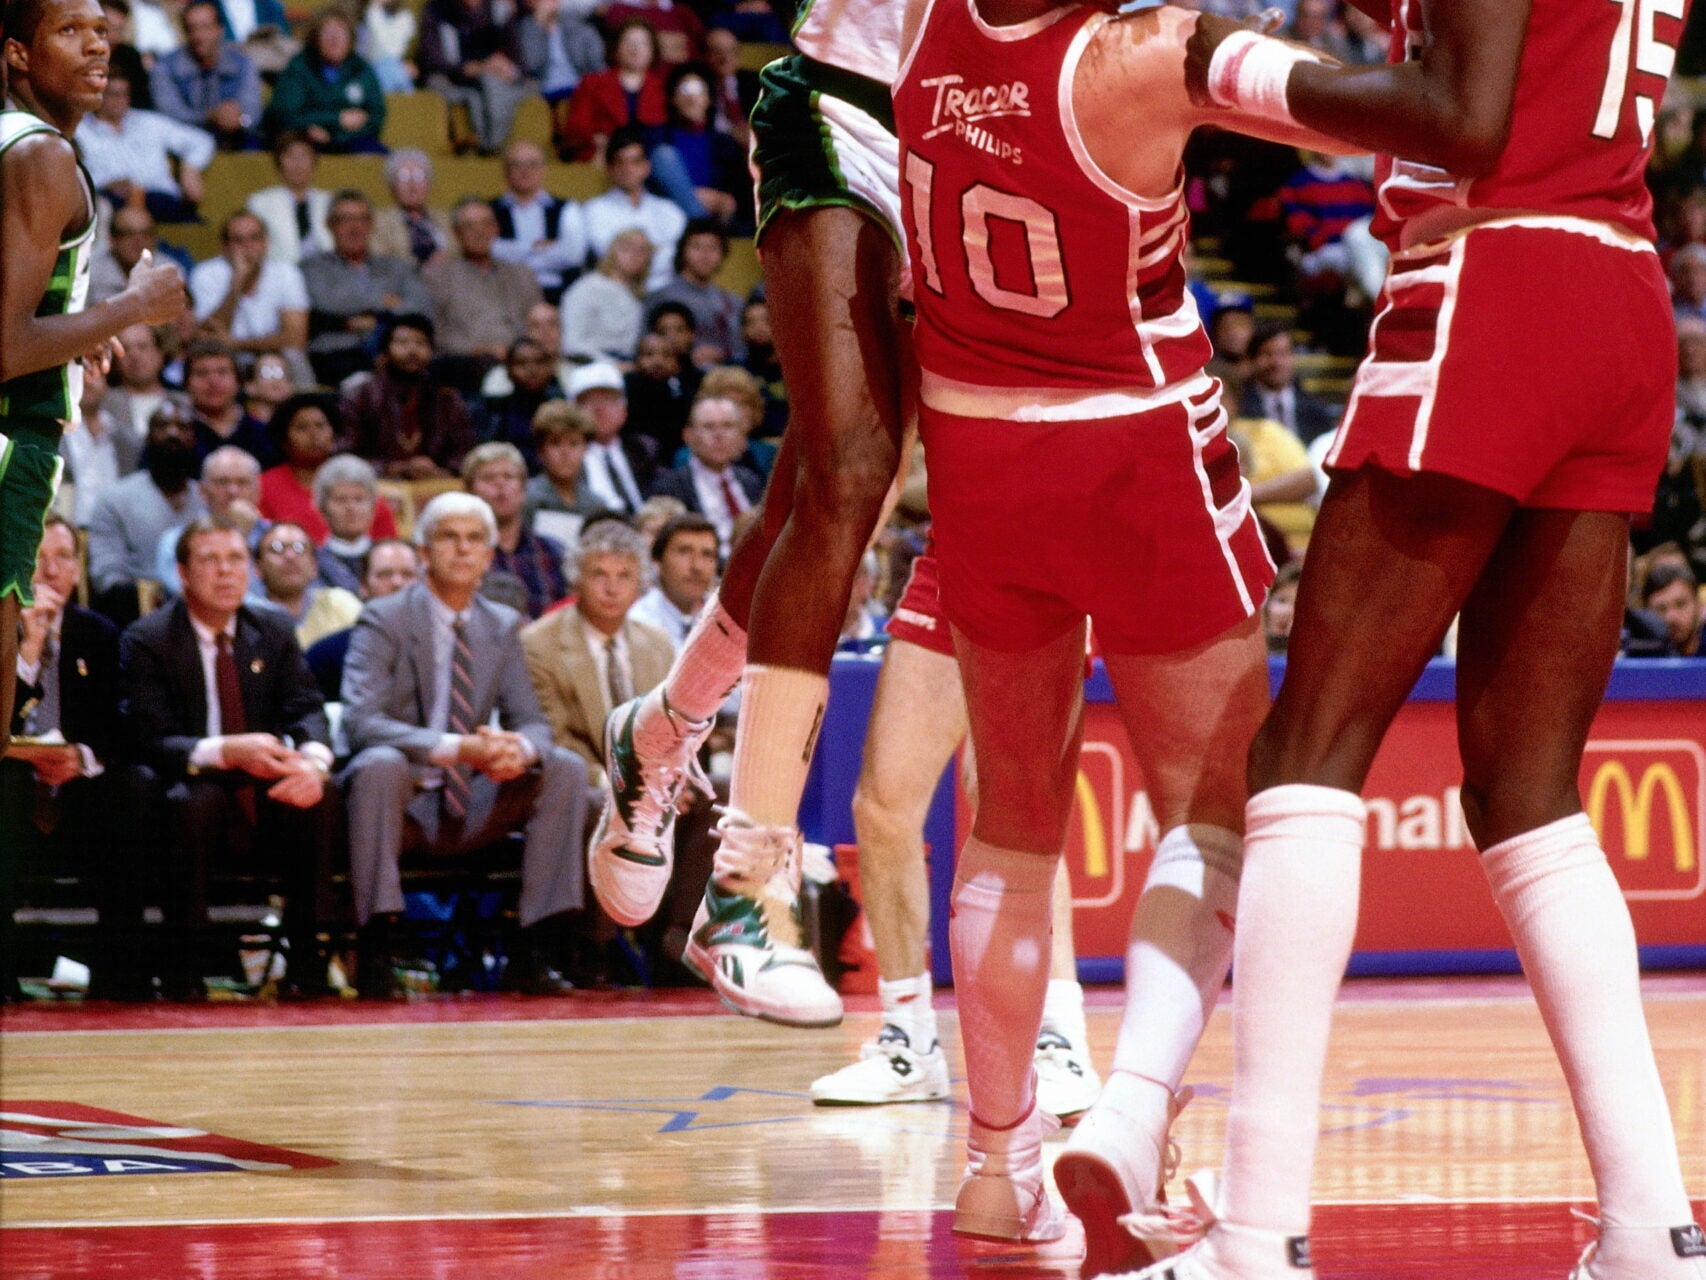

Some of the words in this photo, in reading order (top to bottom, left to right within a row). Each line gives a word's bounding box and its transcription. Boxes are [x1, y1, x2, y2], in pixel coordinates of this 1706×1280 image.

[955, 119, 1023, 165] PHILIPS
[905, 148, 1072, 318] 10
[0, 1160, 187, 1176] BA
